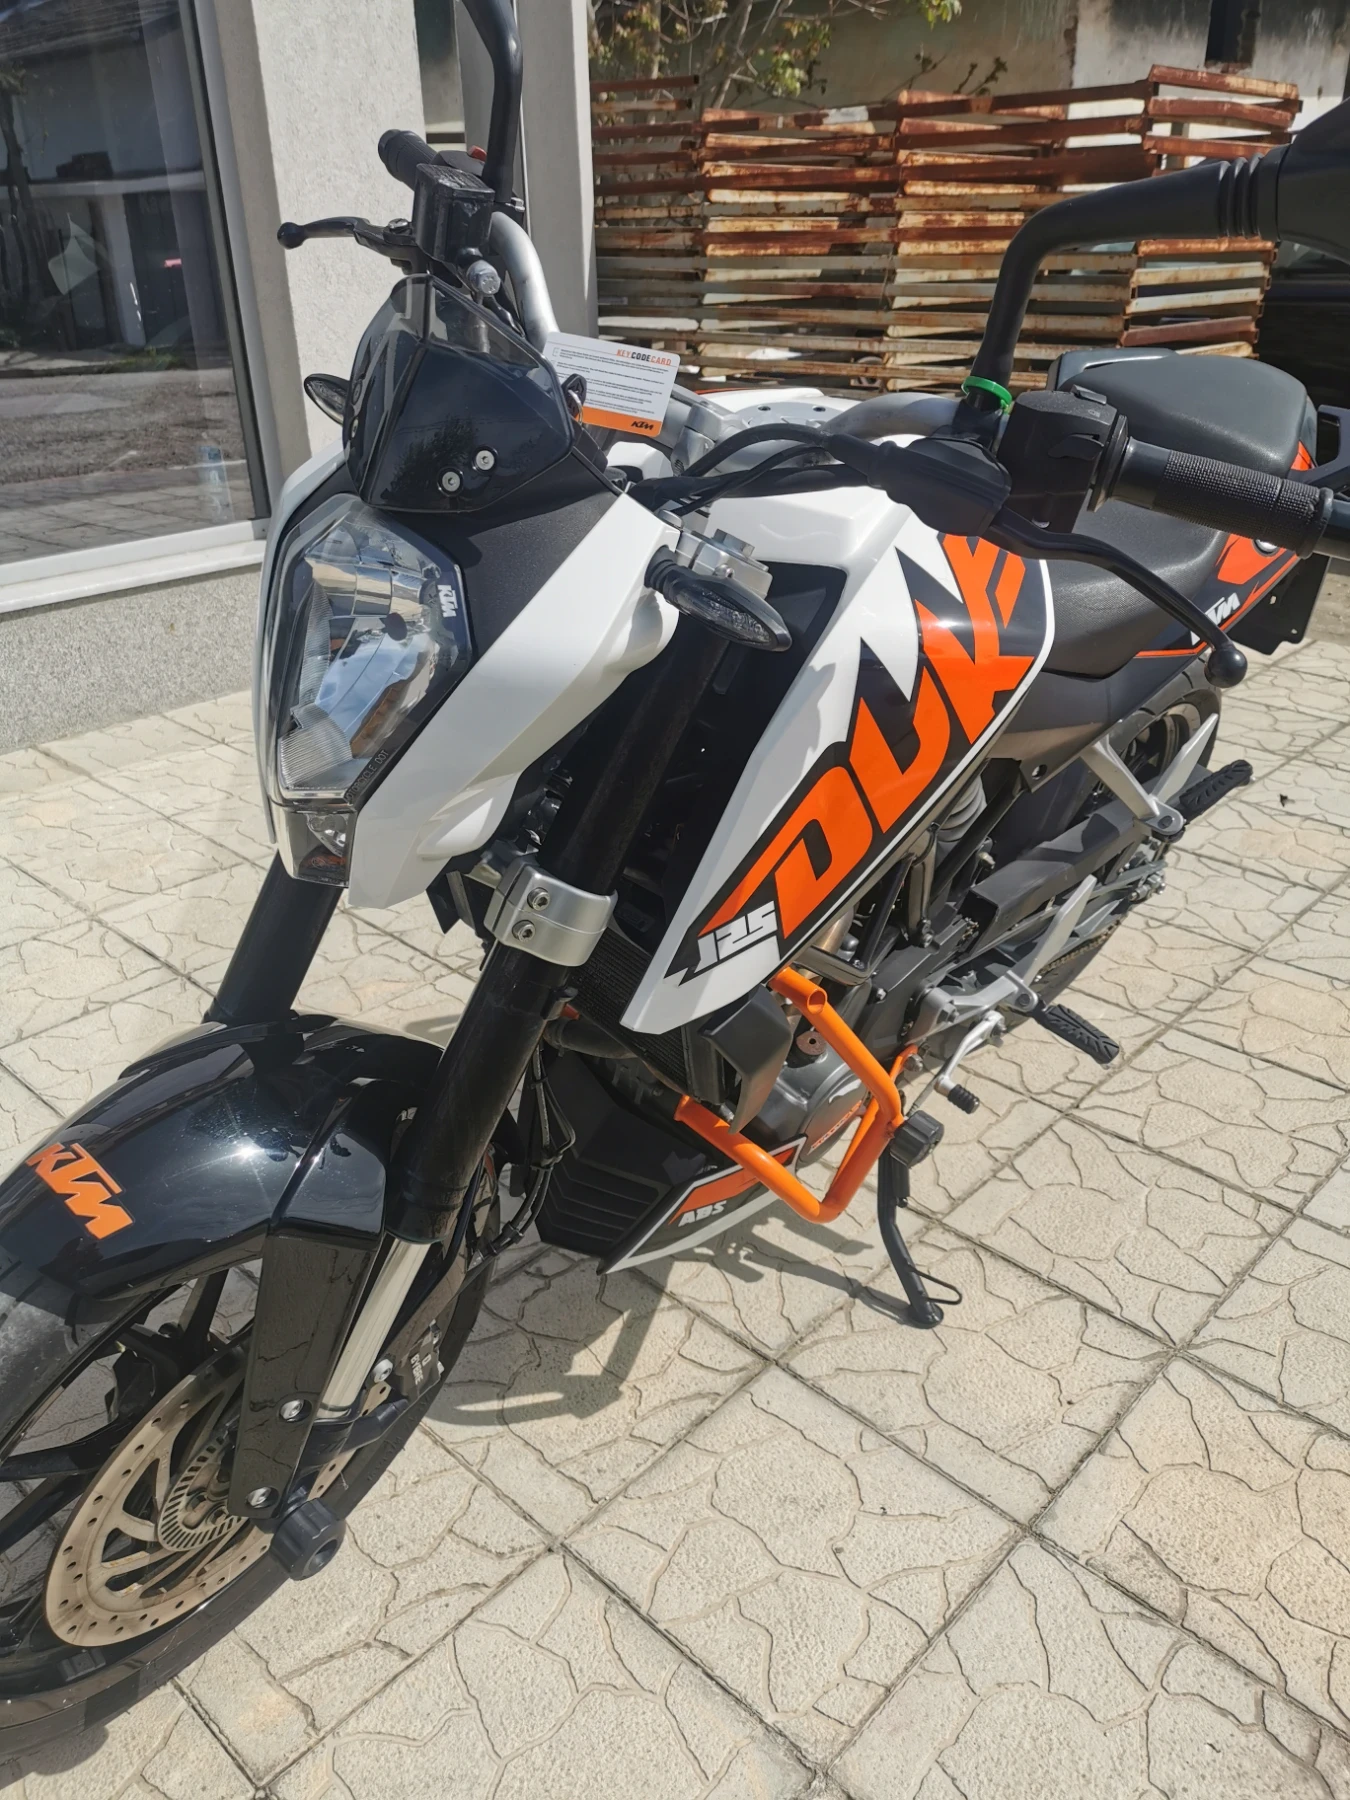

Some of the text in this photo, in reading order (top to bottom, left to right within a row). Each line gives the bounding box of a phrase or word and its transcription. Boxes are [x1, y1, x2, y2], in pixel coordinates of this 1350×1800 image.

[631, 421, 655, 431] KTM
[437, 585, 458, 617] KTM
[1190, 592, 1241, 646] TM
[374, 749, 389, 765] DOT
[694, 900, 778, 973] 125
[26, 1143, 133, 1240] KTM
[678, 1200, 727, 1227] ABS
[410, 1353, 424, 1385] BYBRE
